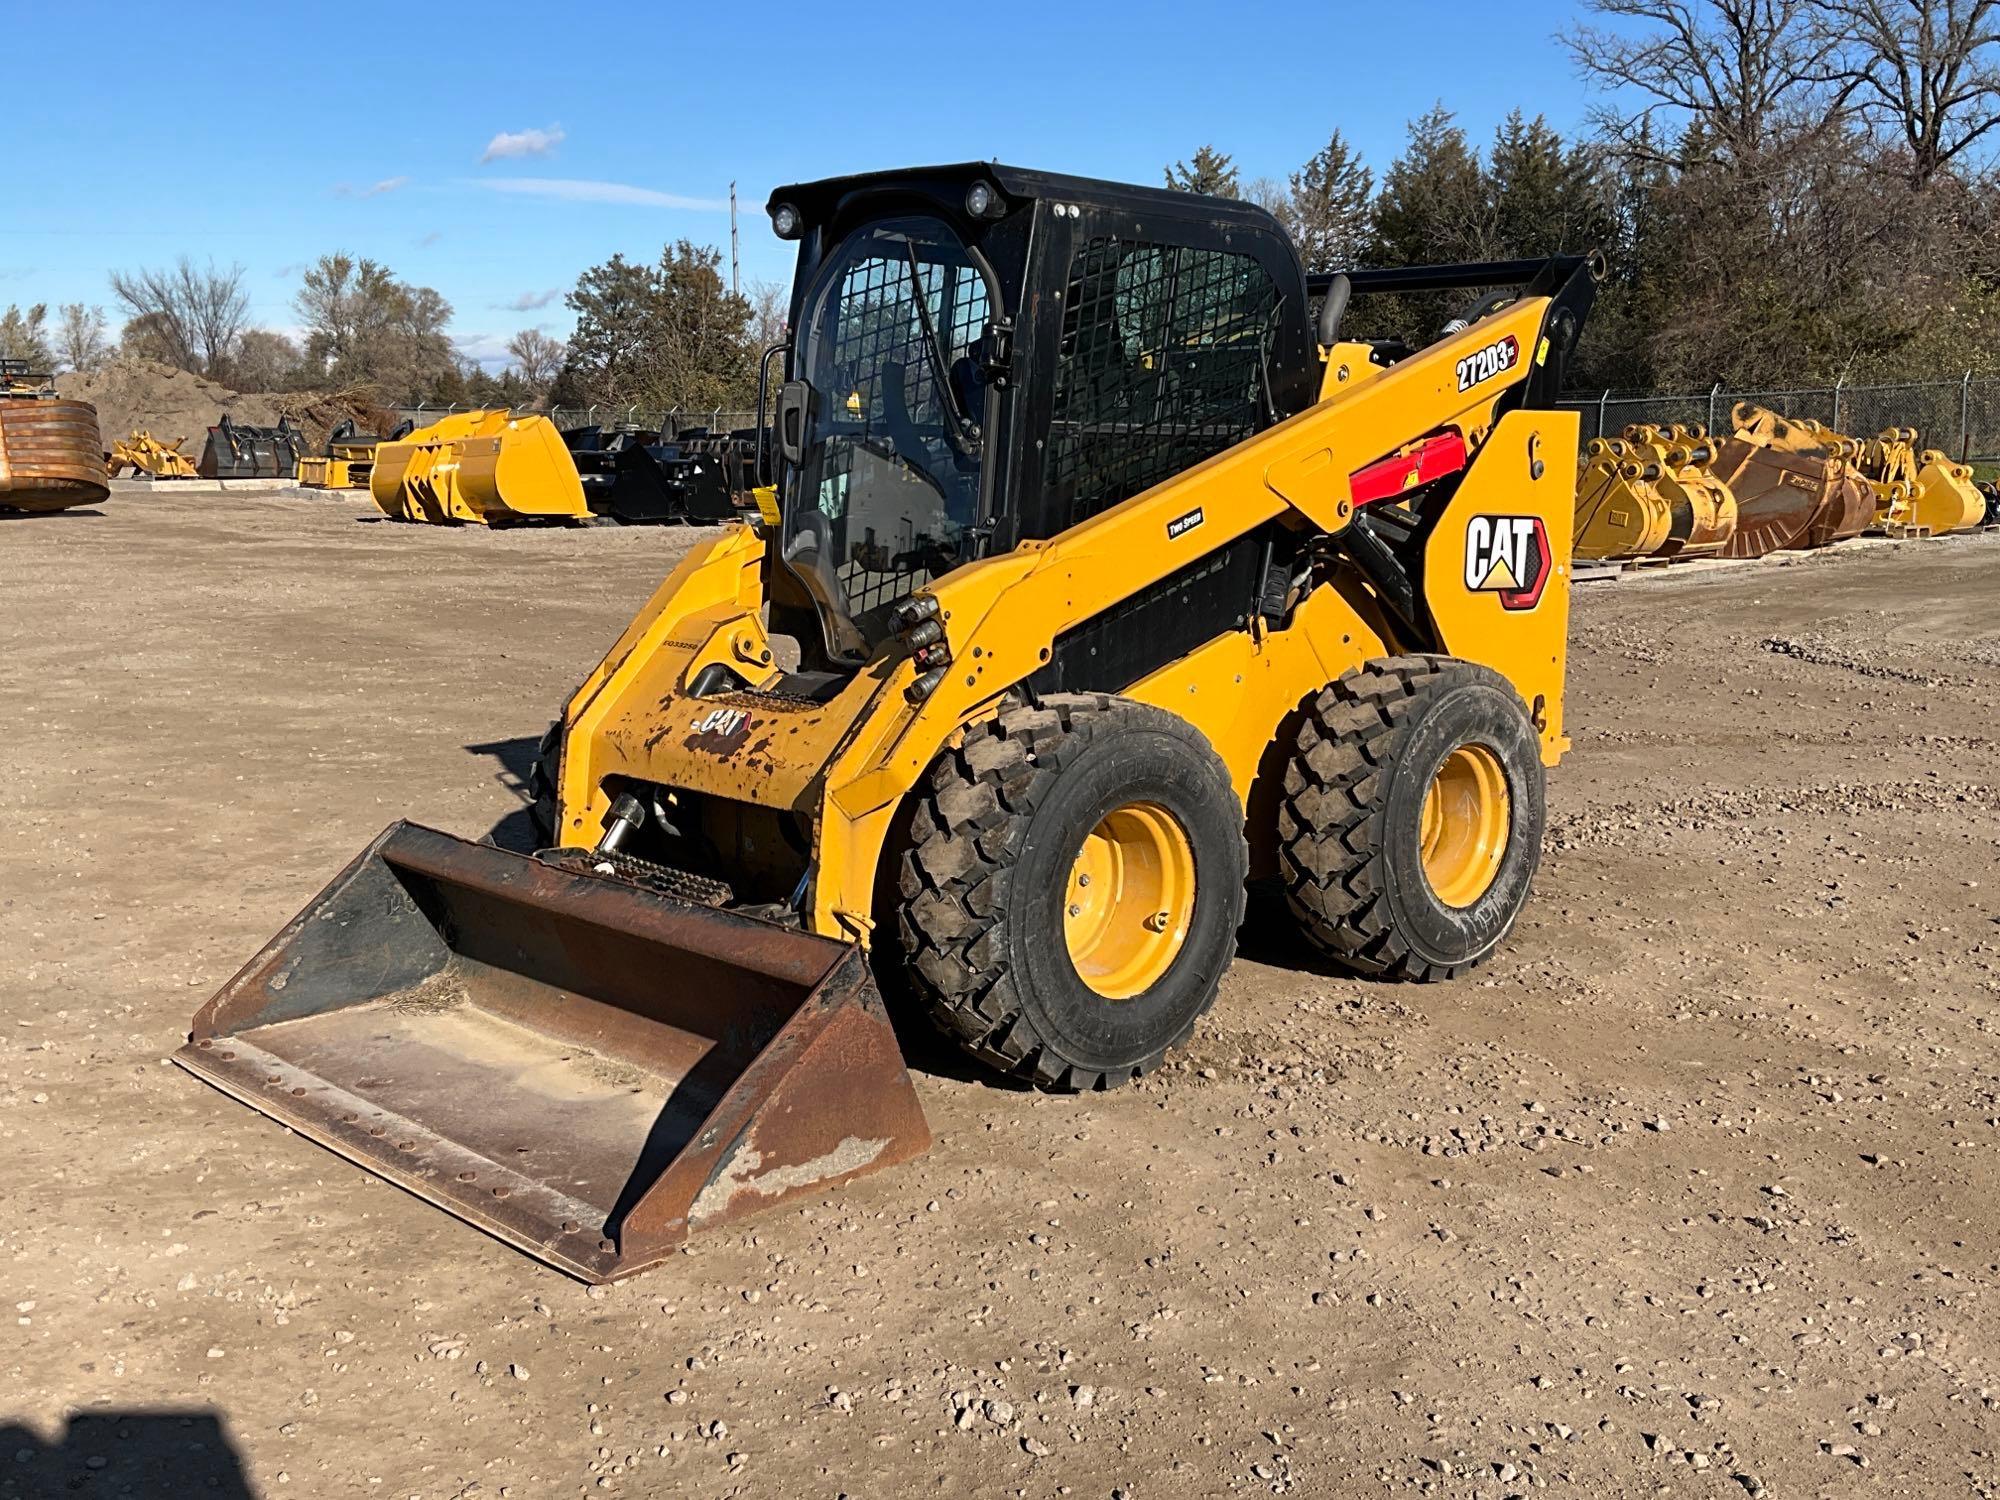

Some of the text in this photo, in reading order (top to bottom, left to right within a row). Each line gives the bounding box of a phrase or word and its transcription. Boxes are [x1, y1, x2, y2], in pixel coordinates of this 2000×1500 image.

[1457, 341, 1508, 391] 272D3
[1465, 516, 1534, 589] CAT
[701, 709, 747, 737] CAT
